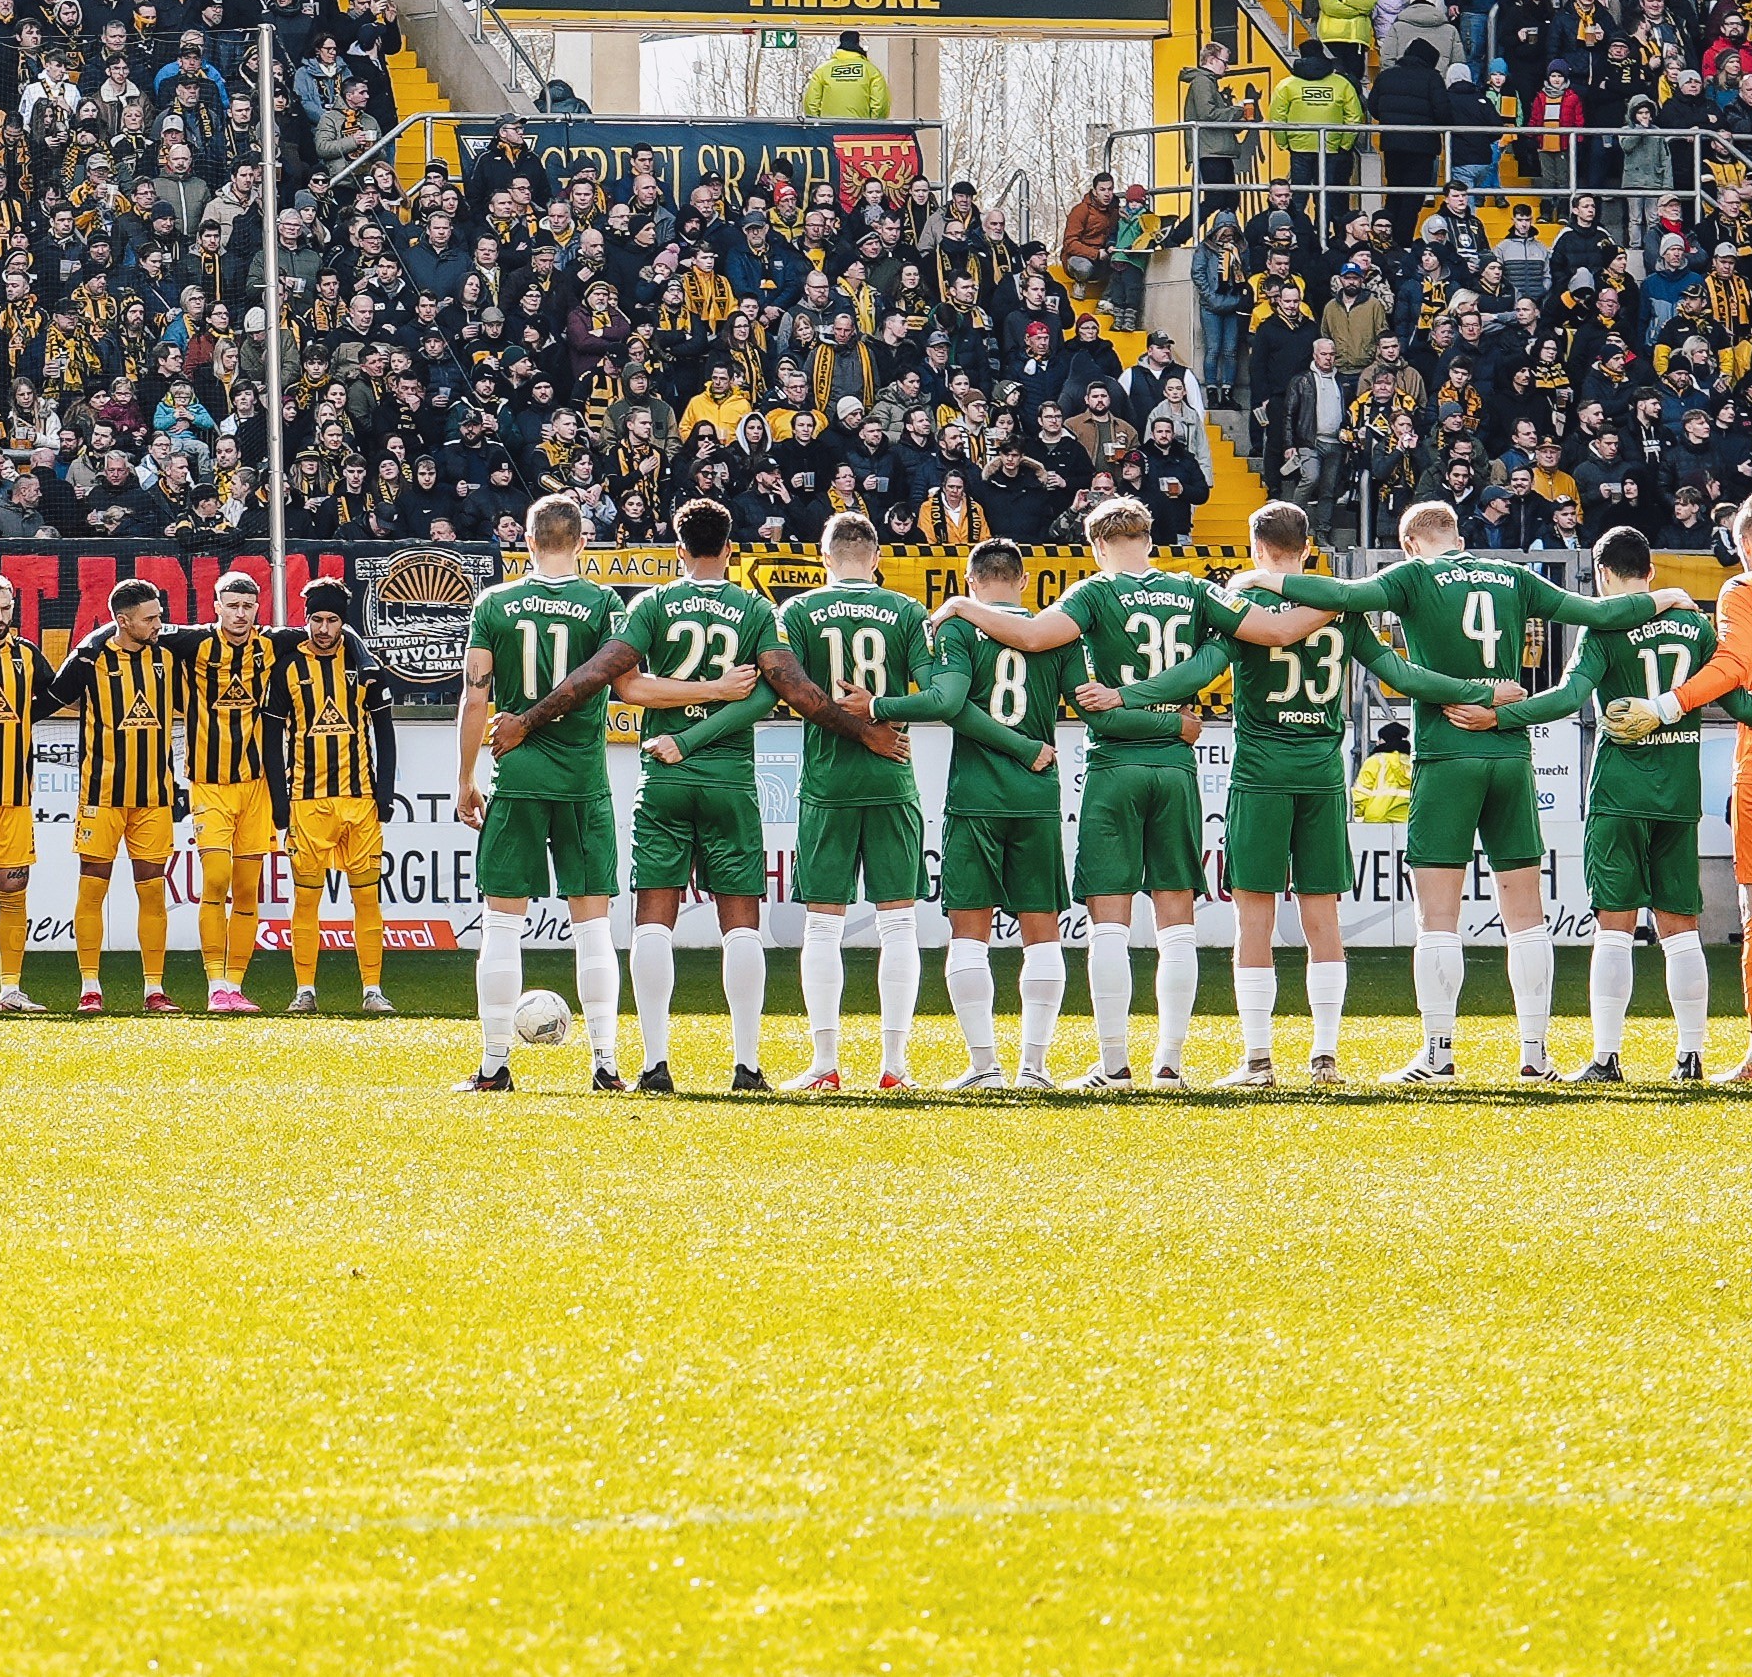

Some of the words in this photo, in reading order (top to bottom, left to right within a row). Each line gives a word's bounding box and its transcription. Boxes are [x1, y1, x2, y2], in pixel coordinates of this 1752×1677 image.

[611, 555, 687, 578] AACHE
[768, 570, 828, 586] ALEMA
[1435, 572, 1451, 587] FC
[925, 568, 963, 610] FA
[503, 601, 521, 618] FC
[522, 595, 593, 623] GÜTERSLOH
[665, 601, 684, 619] FC
[809, 608, 829, 625] FC
[828, 599, 899, 626] GÜTERSLOH
[362, 636, 427, 649] KULTURGUT
[1462, 590, 1503, 669] 4
[1626, 627, 1643, 645] FC
[385, 642, 464, 667] TIVOLI
[514, 619, 569, 700] 11
[665, 620, 740, 681] 23
[1120, 611, 1193, 687] 36
[424, 660, 465, 672] ERHA
[819, 626, 887, 703] 18
[1265, 625, 1344, 704] 53
[1637, 642, 1693, 703] 17
[989, 648, 1028, 727] 8
[1278, 710, 1326, 725] PROBST
[454, 906, 578, 943] Ache
